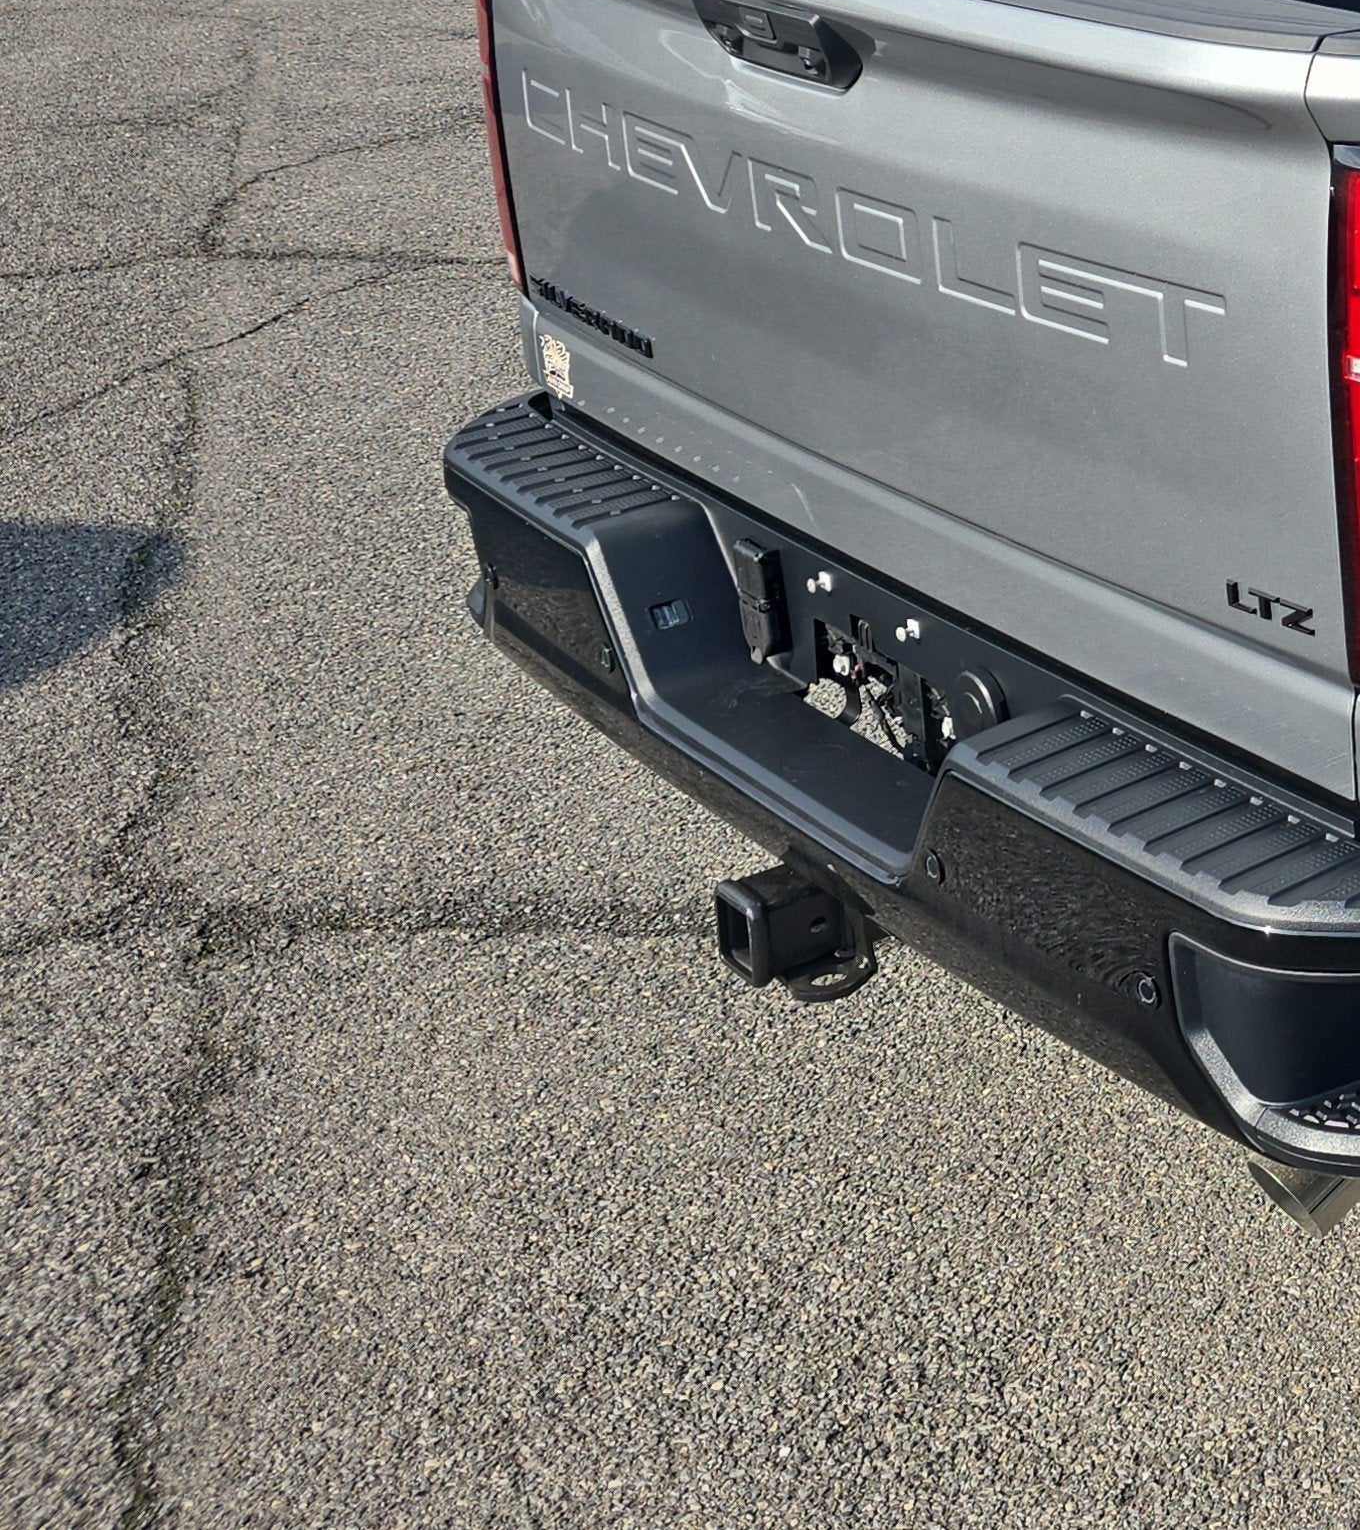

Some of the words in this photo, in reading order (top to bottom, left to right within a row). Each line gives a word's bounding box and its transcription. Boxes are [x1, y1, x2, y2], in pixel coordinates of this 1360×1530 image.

[522, 67, 1226, 368] CHEVROLET
[530, 272, 654, 360] SILVERADO
[1226, 578, 1316, 637] LTZ
